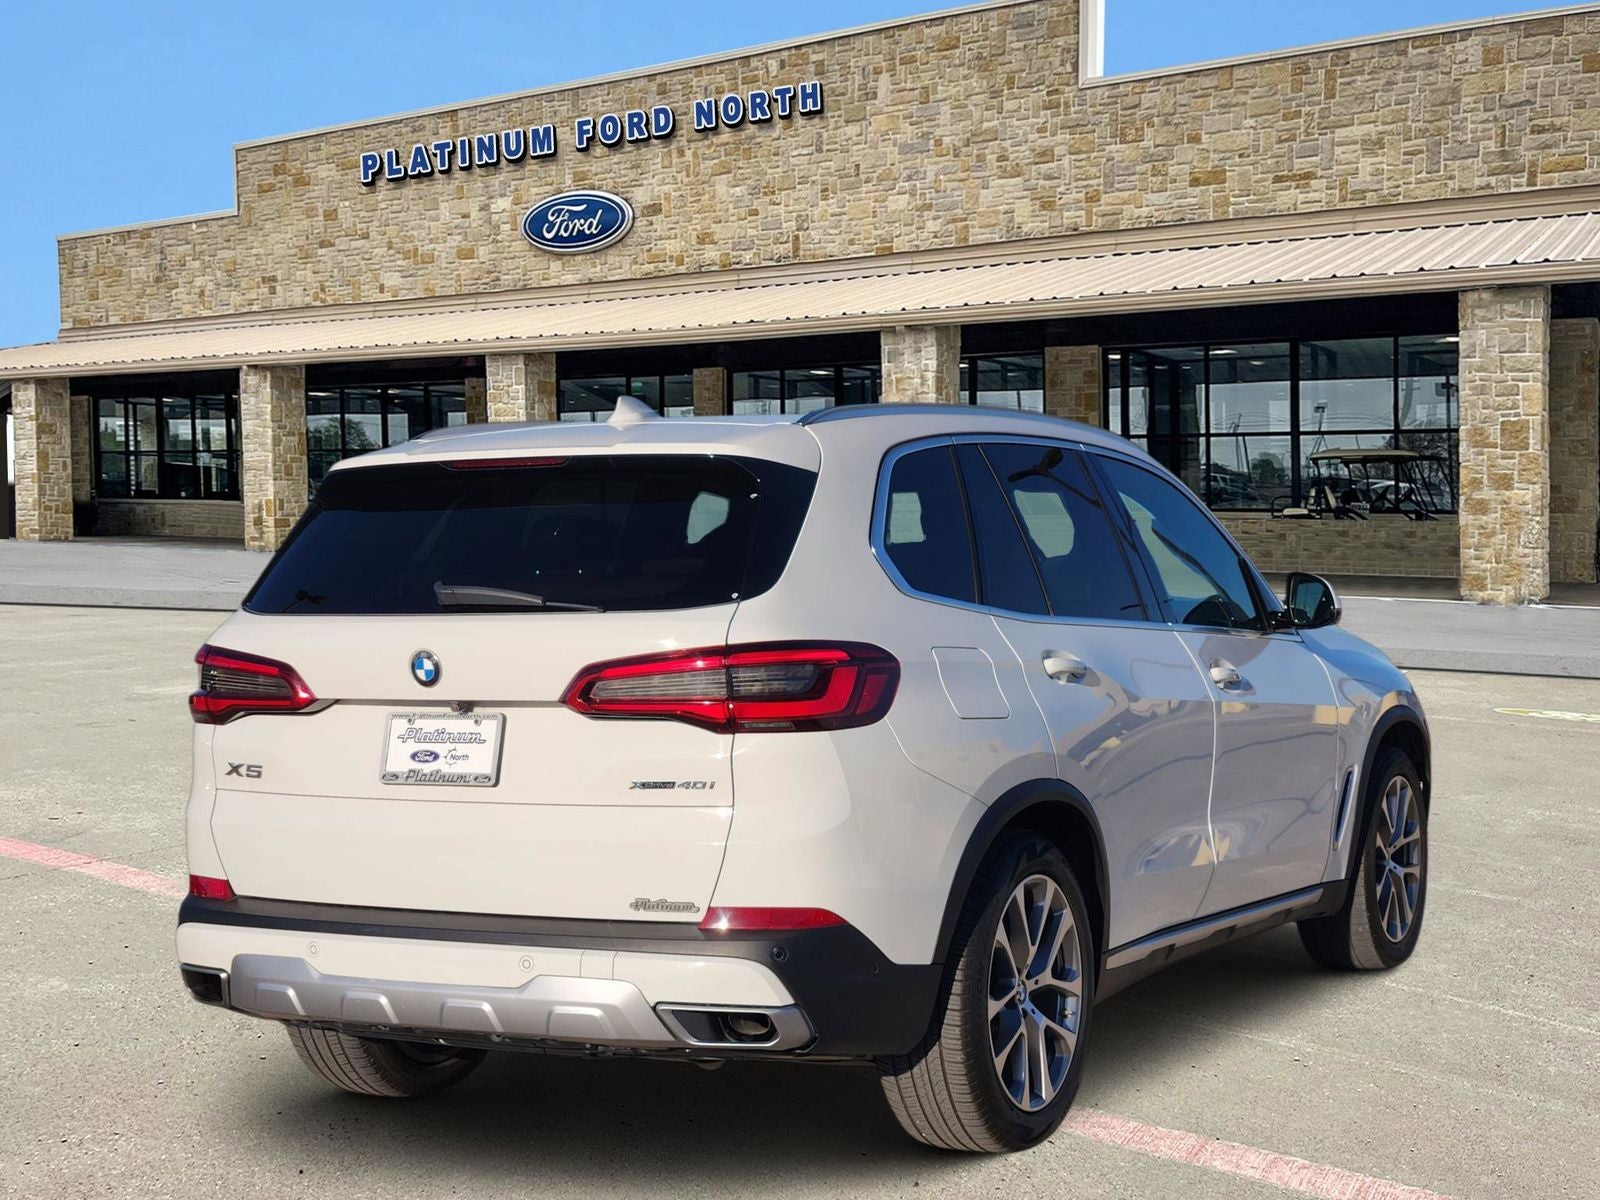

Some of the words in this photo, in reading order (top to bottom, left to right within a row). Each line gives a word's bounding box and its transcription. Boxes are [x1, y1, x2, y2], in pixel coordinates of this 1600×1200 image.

[360, 124, 556, 186] PLATINUM
[575, 105, 675, 152] FORD
[693, 81, 824, 131] NORTH
[542, 203, 602, 240] Ford
[397, 728, 486, 743] Platinum
[450, 753, 469, 761] North
[224, 762, 263, 779] X5
[405, 769, 470, 783] Platinum
[629, 898, 700, 913] Platinum
